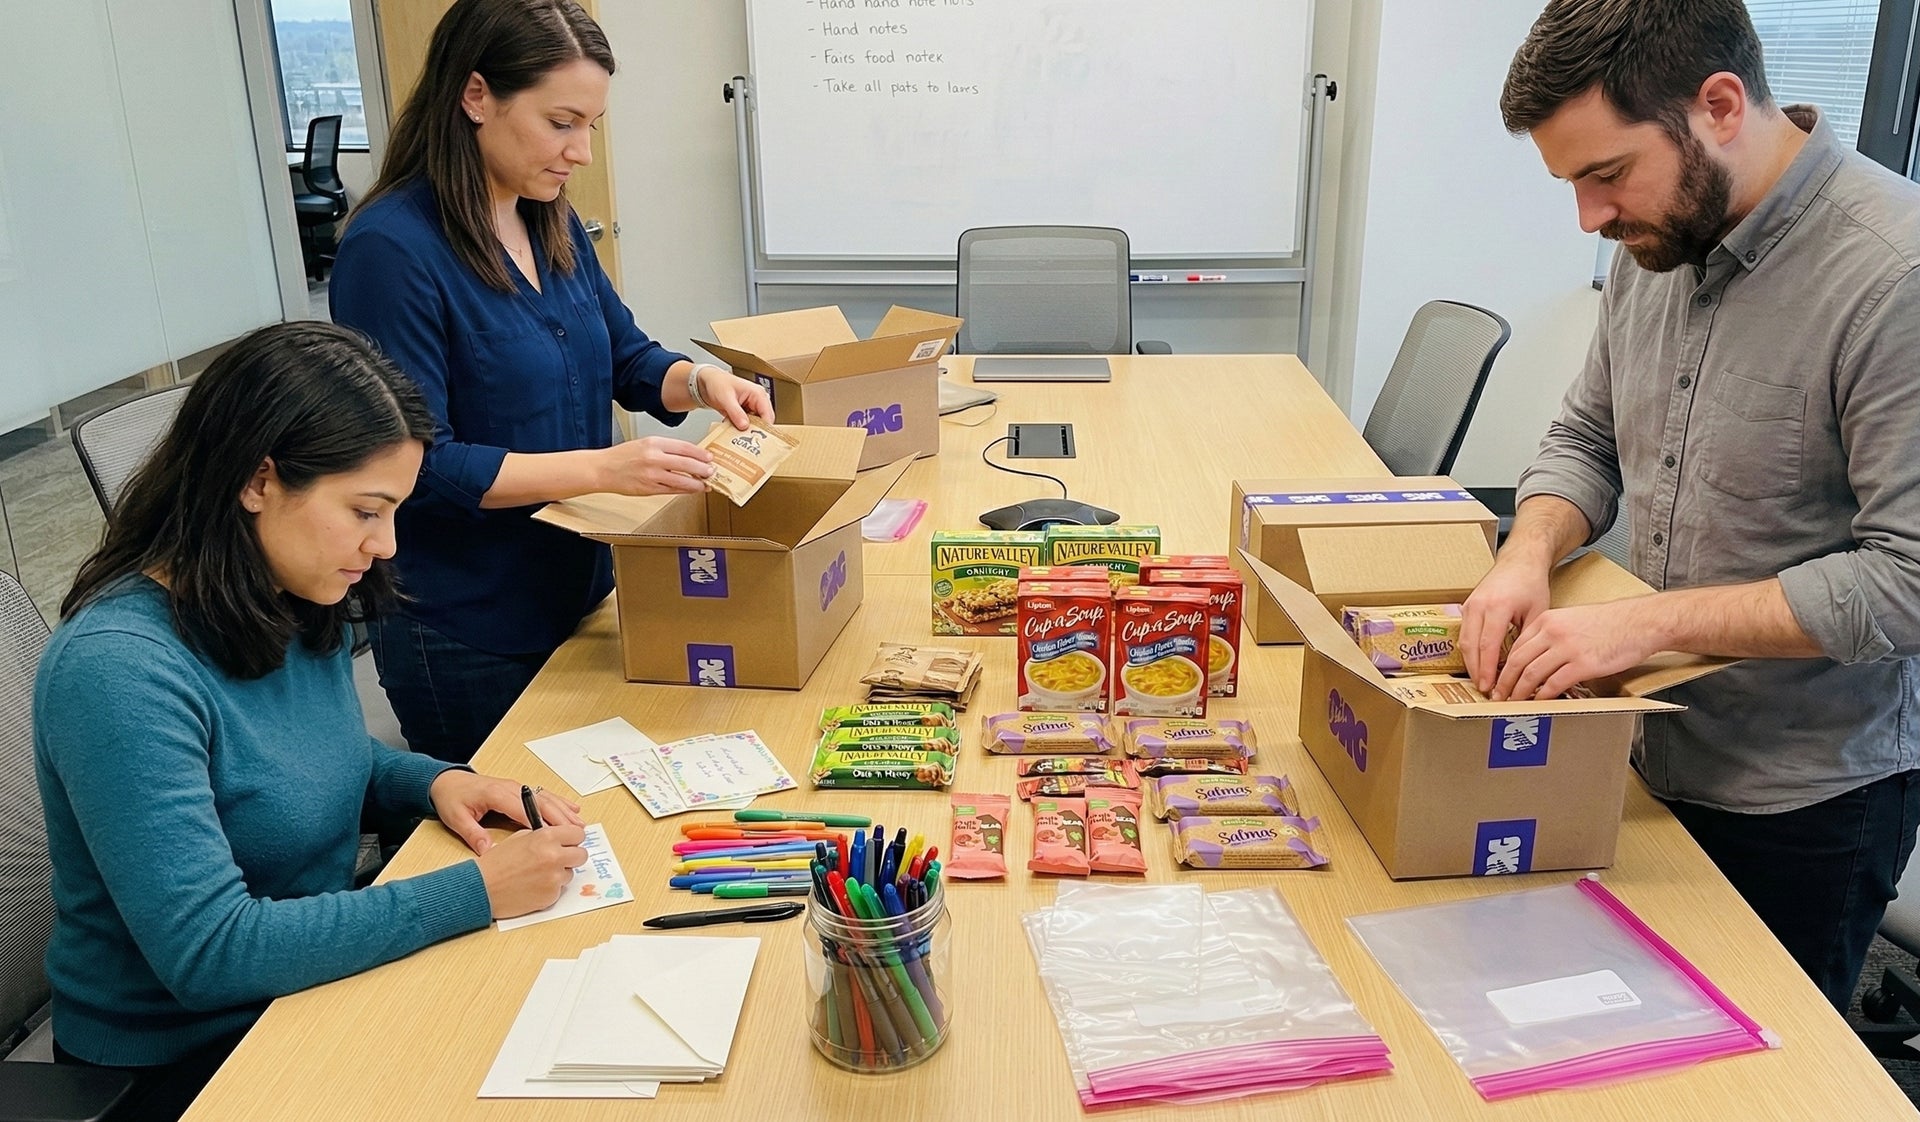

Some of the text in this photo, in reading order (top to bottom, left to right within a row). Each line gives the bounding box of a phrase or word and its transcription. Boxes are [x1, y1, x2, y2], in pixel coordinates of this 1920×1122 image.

[822, 21, 908, 36] Hand notes
[865, 50, 895, 64] food
[823, 78, 857, 93] Take
[864, 80, 881, 92] all
[927, 81, 940, 93] to
[940, 547, 1036, 567] NATURE VALLEY
[1057, 542, 1105, 561] NATURE
[1399, 640, 1454, 660] Salmas
[1023, 721, 1076, 734] Salmas
[1163, 728, 1216, 740] Salmas
[1195, 785, 1252, 800] Salmas
[1218, 828, 1278, 845] Salmas
